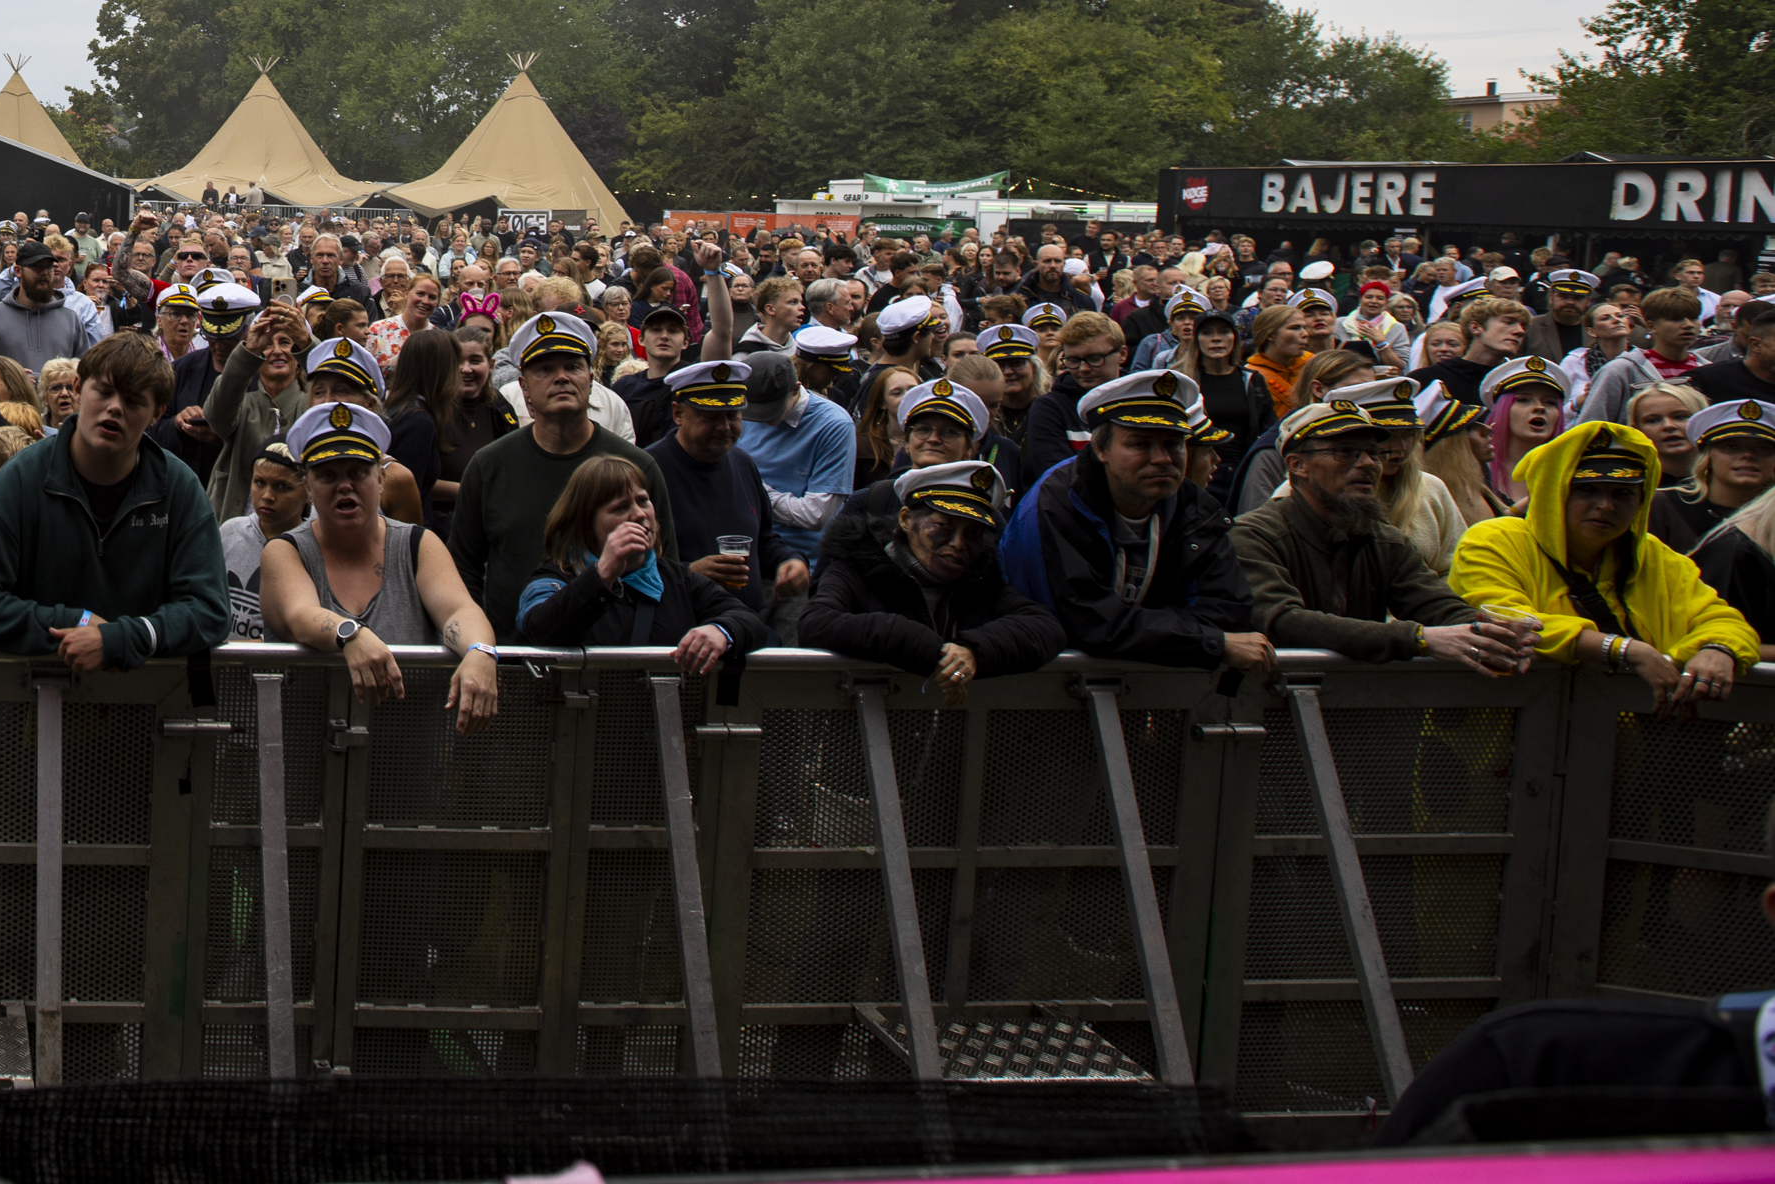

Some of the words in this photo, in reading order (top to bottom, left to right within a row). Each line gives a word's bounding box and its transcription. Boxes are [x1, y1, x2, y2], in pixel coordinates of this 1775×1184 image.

[912, 183, 971, 193] EMERGENCY
[970, 177, 993, 188] EXIT
[1182, 185, 1209, 200] KØGE
[1260, 171, 1438, 217] BAJERE
[1609, 168, 1775, 223] DRIN
[507, 214, 546, 234] ØGE
[916, 224, 933, 232] EXIT
